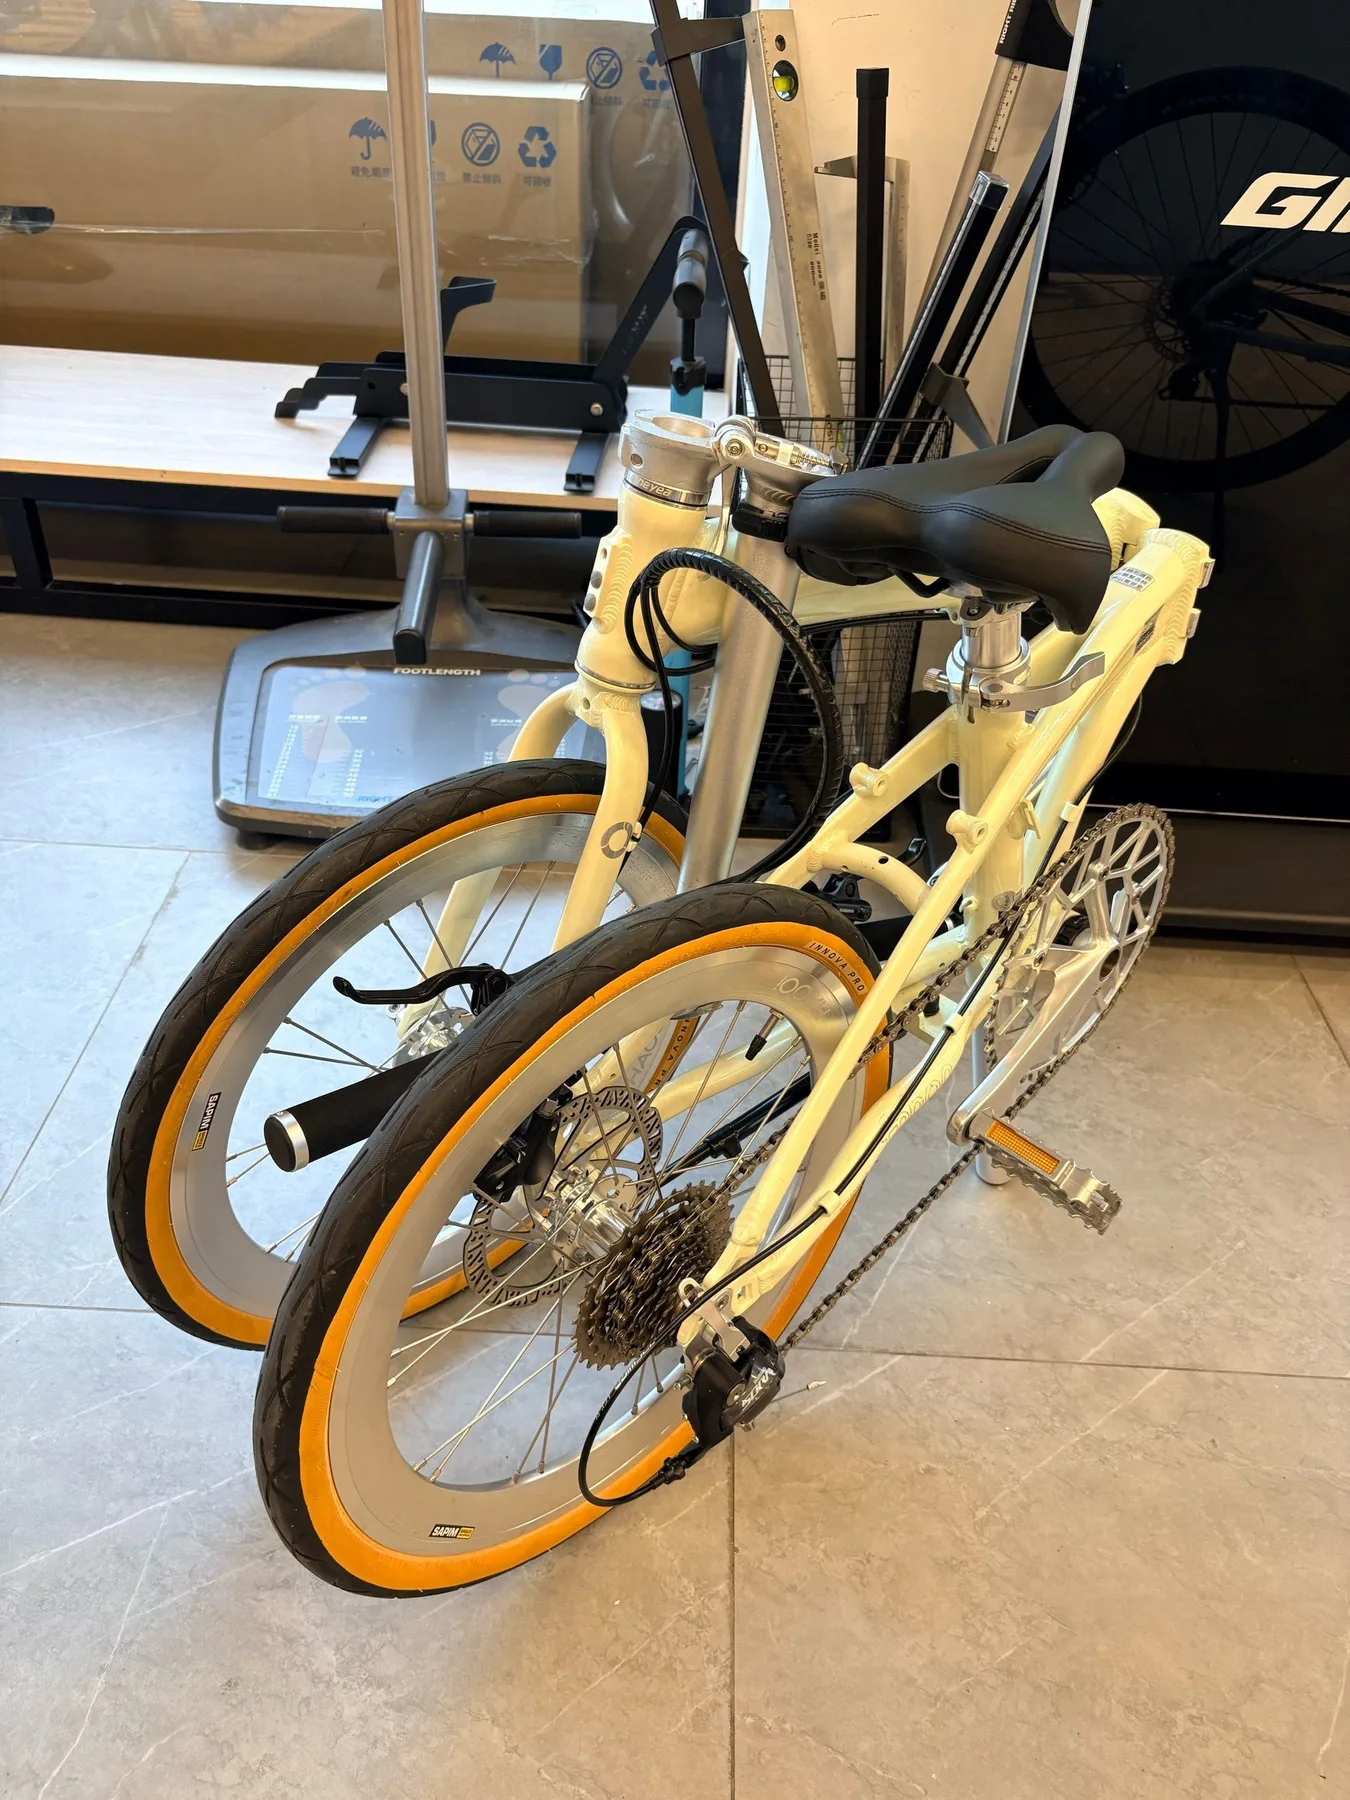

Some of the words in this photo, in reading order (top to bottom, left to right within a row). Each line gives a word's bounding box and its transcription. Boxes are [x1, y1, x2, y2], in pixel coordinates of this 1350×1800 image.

[1220, 171, 1350, 234] GI
[812, 232, 821, 256] Model
[393, 667, 481, 676] FOOTLENGTH
[808, 942, 848, 970] INNOVA
[847, 971, 866, 992] PRO
[667, 1017, 691, 1061] NOVA
[200, 1094, 219, 1130] SAPIM
[432, 1526, 459, 1537] SAPIM
